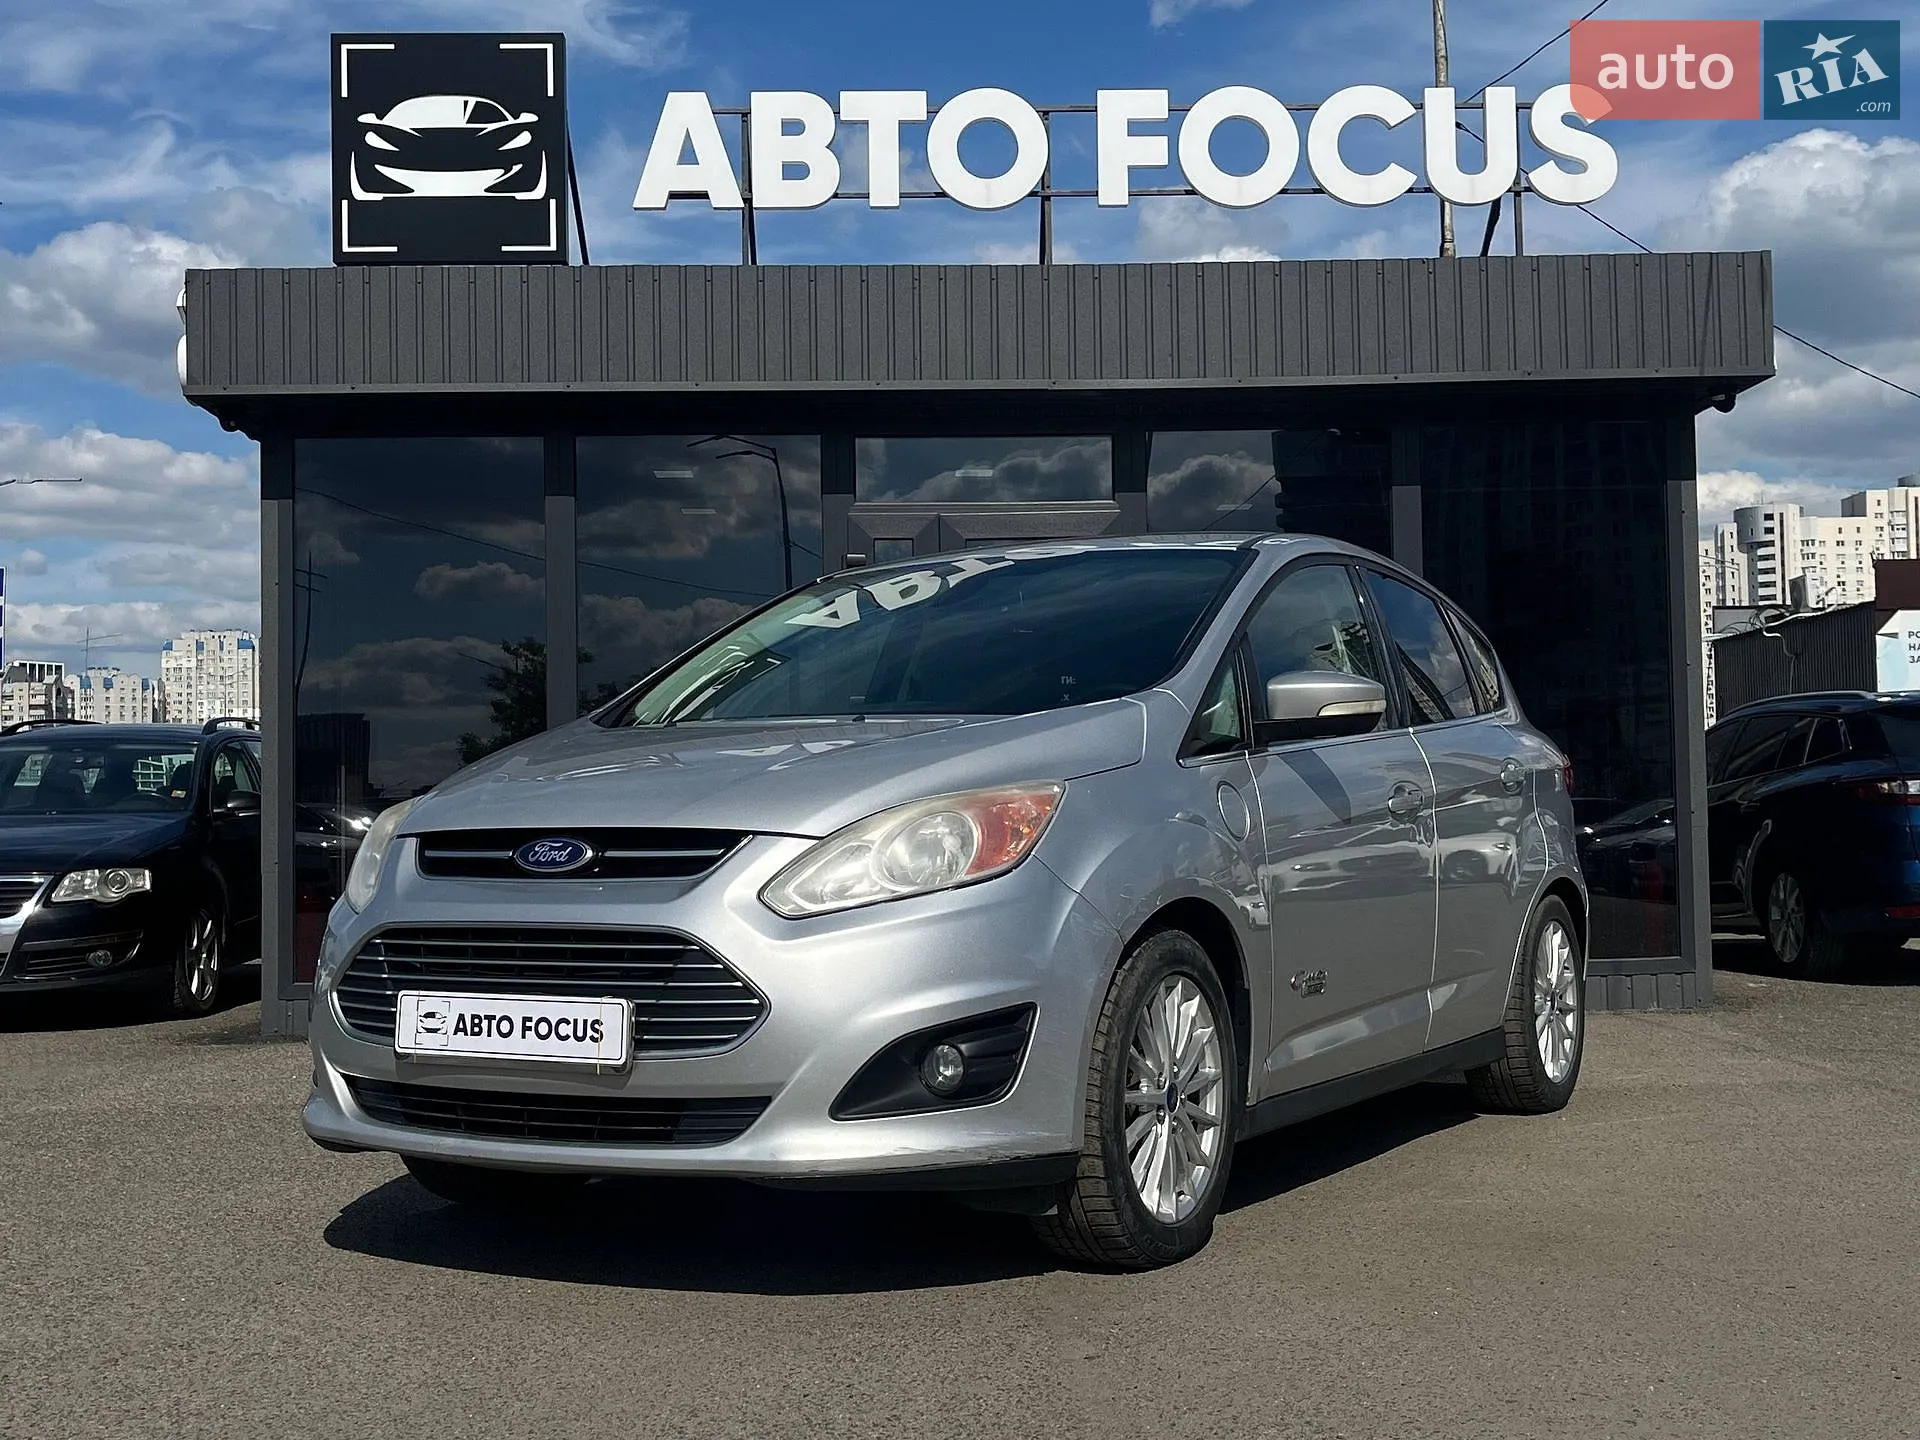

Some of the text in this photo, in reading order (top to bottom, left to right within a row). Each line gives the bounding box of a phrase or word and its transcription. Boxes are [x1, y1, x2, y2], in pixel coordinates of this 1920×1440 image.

[633, 84, 1620, 210] АВТО FOCUS
[528, 841, 573, 862] Ford
[452, 1012, 604, 1043] АВТО FOCUS
